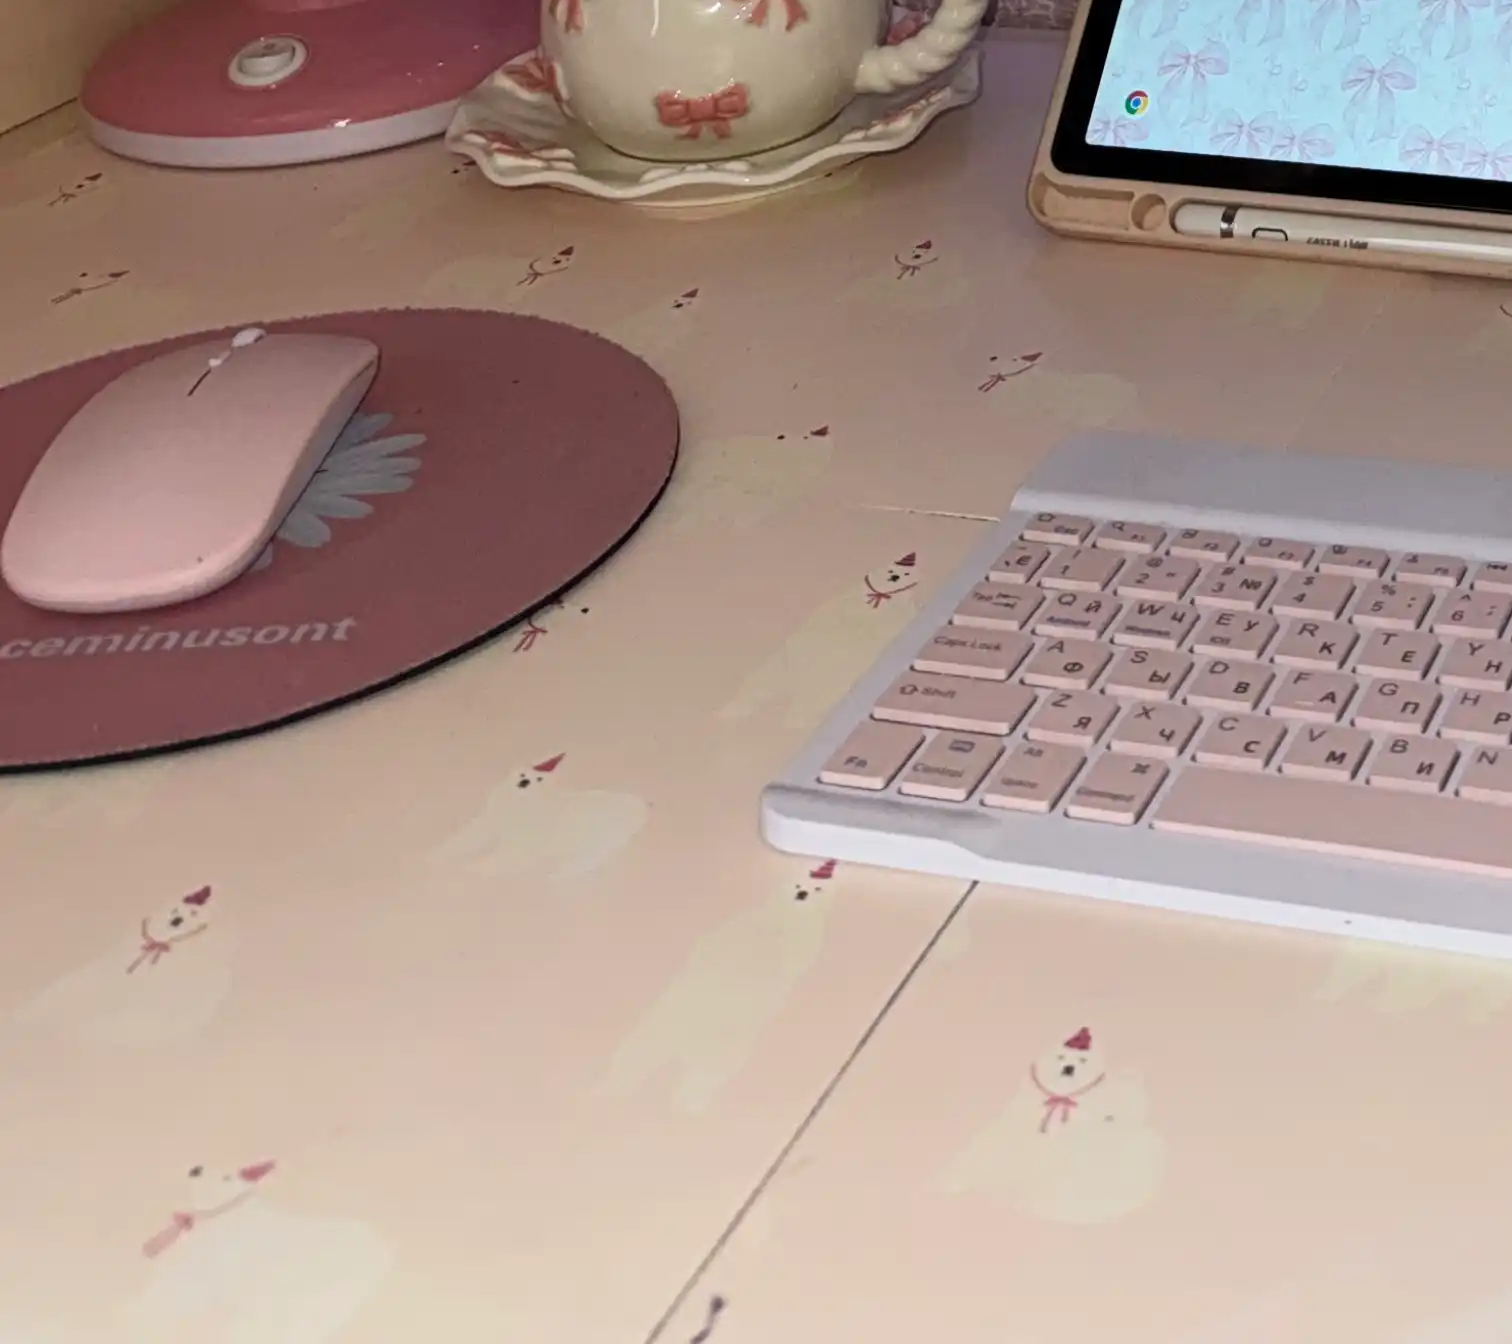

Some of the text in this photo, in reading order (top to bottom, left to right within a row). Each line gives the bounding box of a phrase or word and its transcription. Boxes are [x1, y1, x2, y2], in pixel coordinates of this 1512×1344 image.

[1060, 564, 1070, 575] 1
[1135, 573, 1150, 584] 2
[1211, 582, 1226, 594] 3
[1058, 593, 1077, 607] Q
[1291, 593, 1307, 603] 4
[1084, 600, 1102, 614] Й
[1138, 604, 1165, 616] W
[1370, 601, 1385, 612] 5
[1216, 613, 1235, 626] E
[1450, 610, 1465, 622] 6
[1298, 623, 1319, 637] R
[1382, 632, 1399, 646] T
[1047, 640, 1065, 653] A
[1318, 641, 1337, 655] К
[1468, 642, 1485, 656] Y
[1130, 650, 1149, 664] S
[1063, 661, 1084, 673] Ф
[1208, 660, 1229, 674] D
[1485, 660, 1503, 673] Н
[1148, 670, 1172, 684] Ы
[1292, 672, 1311, 685] F
[921, 685, 956, 699] Shift
[1232, 681, 1251, 694] В
[1378, 682, 1399, 696] G
[1051, 693, 1073, 708] Z
[1318, 691, 1337, 704] А
[1459, 692, 1481, 706] H
[1133, 705, 1157, 720] X
[1400, 700, 1420, 714] П
[1072, 716, 1092, 730] Я
[1218, 716, 1239, 731] C
[1493, 711, 1512, 725] Р
[1159, 728, 1176, 742] Ч
[1308, 728, 1328, 742] V
[1243, 739, 1261, 753] С
[1389, 739, 1409, 754] B
[843, 755, 868, 768] Fn
[1324, 750, 1348, 765] М
[1476, 750, 1499, 766] N
[912, 762, 964, 778] Control
[1415, 761, 1435, 775] И
